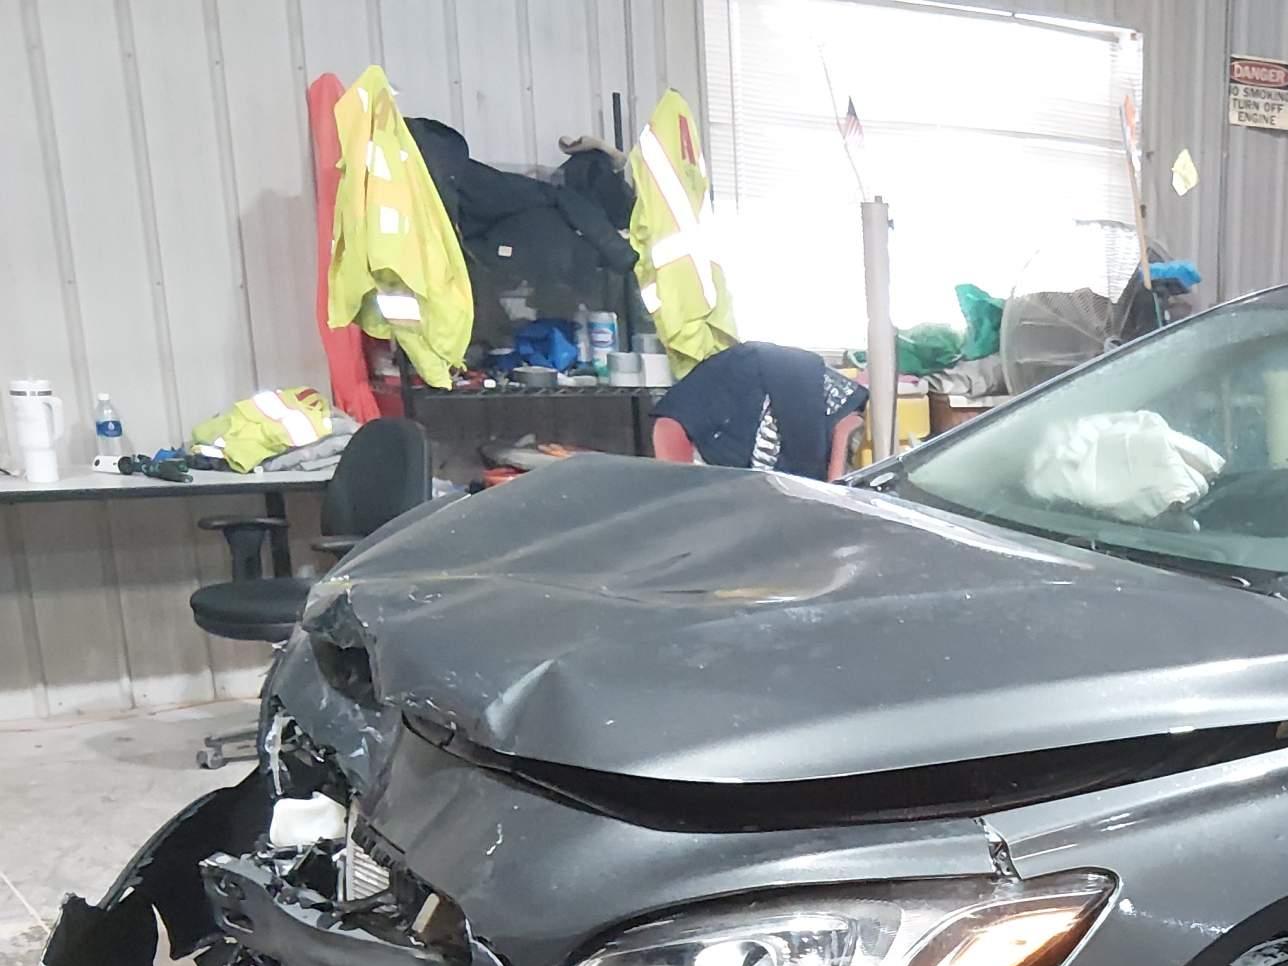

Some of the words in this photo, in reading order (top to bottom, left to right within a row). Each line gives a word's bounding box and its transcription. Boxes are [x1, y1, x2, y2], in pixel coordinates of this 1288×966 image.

[1233, 63, 1286, 84] DANGER
[1231, 86, 1240, 97] O
[1232, 98, 1260, 111] TURN
[1263, 102, 1285, 113] OFF
[1237, 111, 1277, 126] ENGINE
